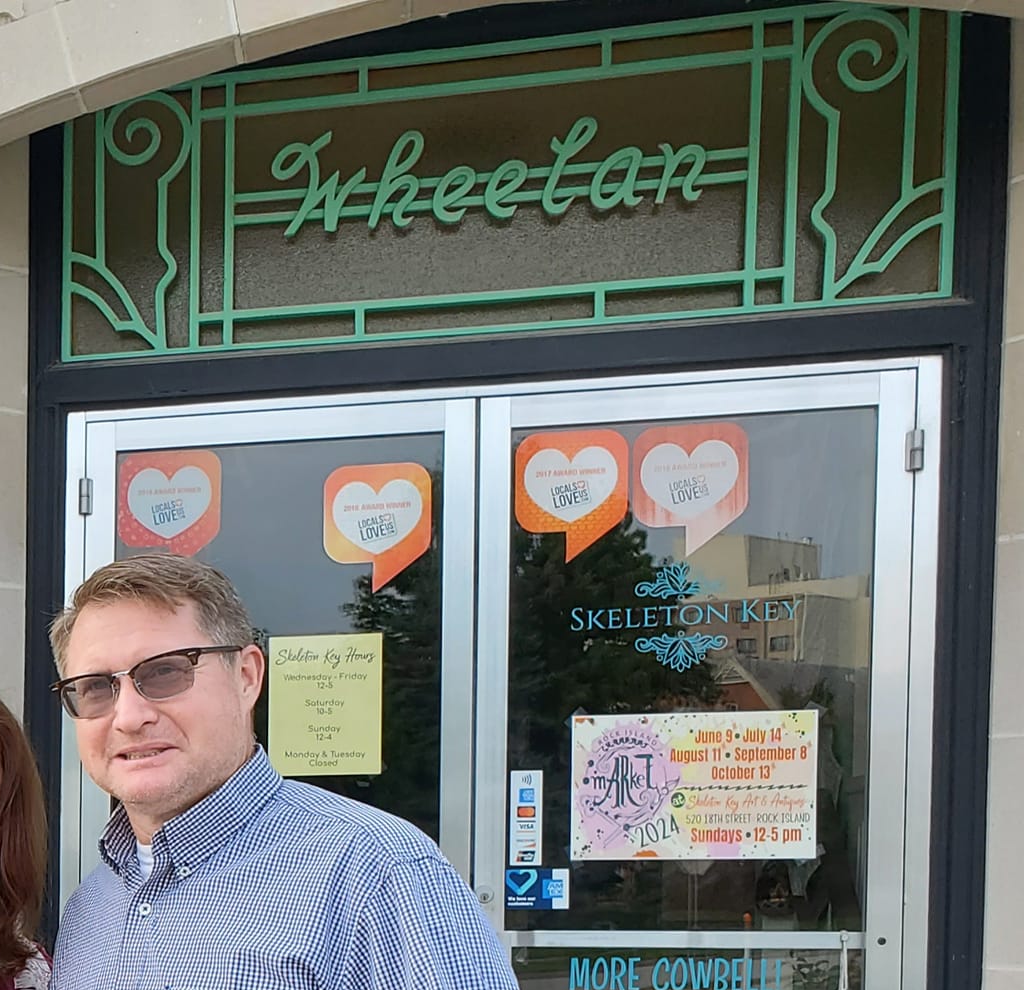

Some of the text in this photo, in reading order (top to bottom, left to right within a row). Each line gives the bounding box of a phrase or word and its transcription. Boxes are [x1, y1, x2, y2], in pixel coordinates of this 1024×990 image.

[271, 115, 707, 239] Wheelan
[551, 482, 577, 496] LOCALS
[669, 477, 697, 492] LOCALS
[553, 489, 588, 508] LOVE US
[671, 484, 709, 504] LOVE US
[151, 500, 176, 514] LOCALS
[153, 509, 178, 526] LOVE
[358, 515, 384, 529] LOCALS
[360, 521, 394, 541] LOVE US
[570, 598, 802, 632] SKELETON KEY
[276, 647, 376, 669] Skeleton Key Hours
[283, 673, 332, 682] Wednesday
[339, 672, 368, 681] Friday
[305, 699, 345, 708] Saturday
[308, 724, 341, 734] Sunday
[695, 729, 722, 744] June
[743, 728, 767, 744] July
[598, 730, 620, 745] ROCK
[625, 729, 657, 746] ISLAND
[285, 750, 366, 760] Monday & Tuesday
[670, 748, 709, 764] August
[734, 746, 796, 763] September
[309, 759, 338, 767] Closed
[711, 766, 756, 780] October
[672, 793, 684, 805] at
[725, 794, 739, 813] Key
[686, 812, 811, 824] 520 18TH STREET ROCK ISLAND
[635, 814, 680, 848] 2024
[690, 827, 802, 844] Sundays 12-5 pm
